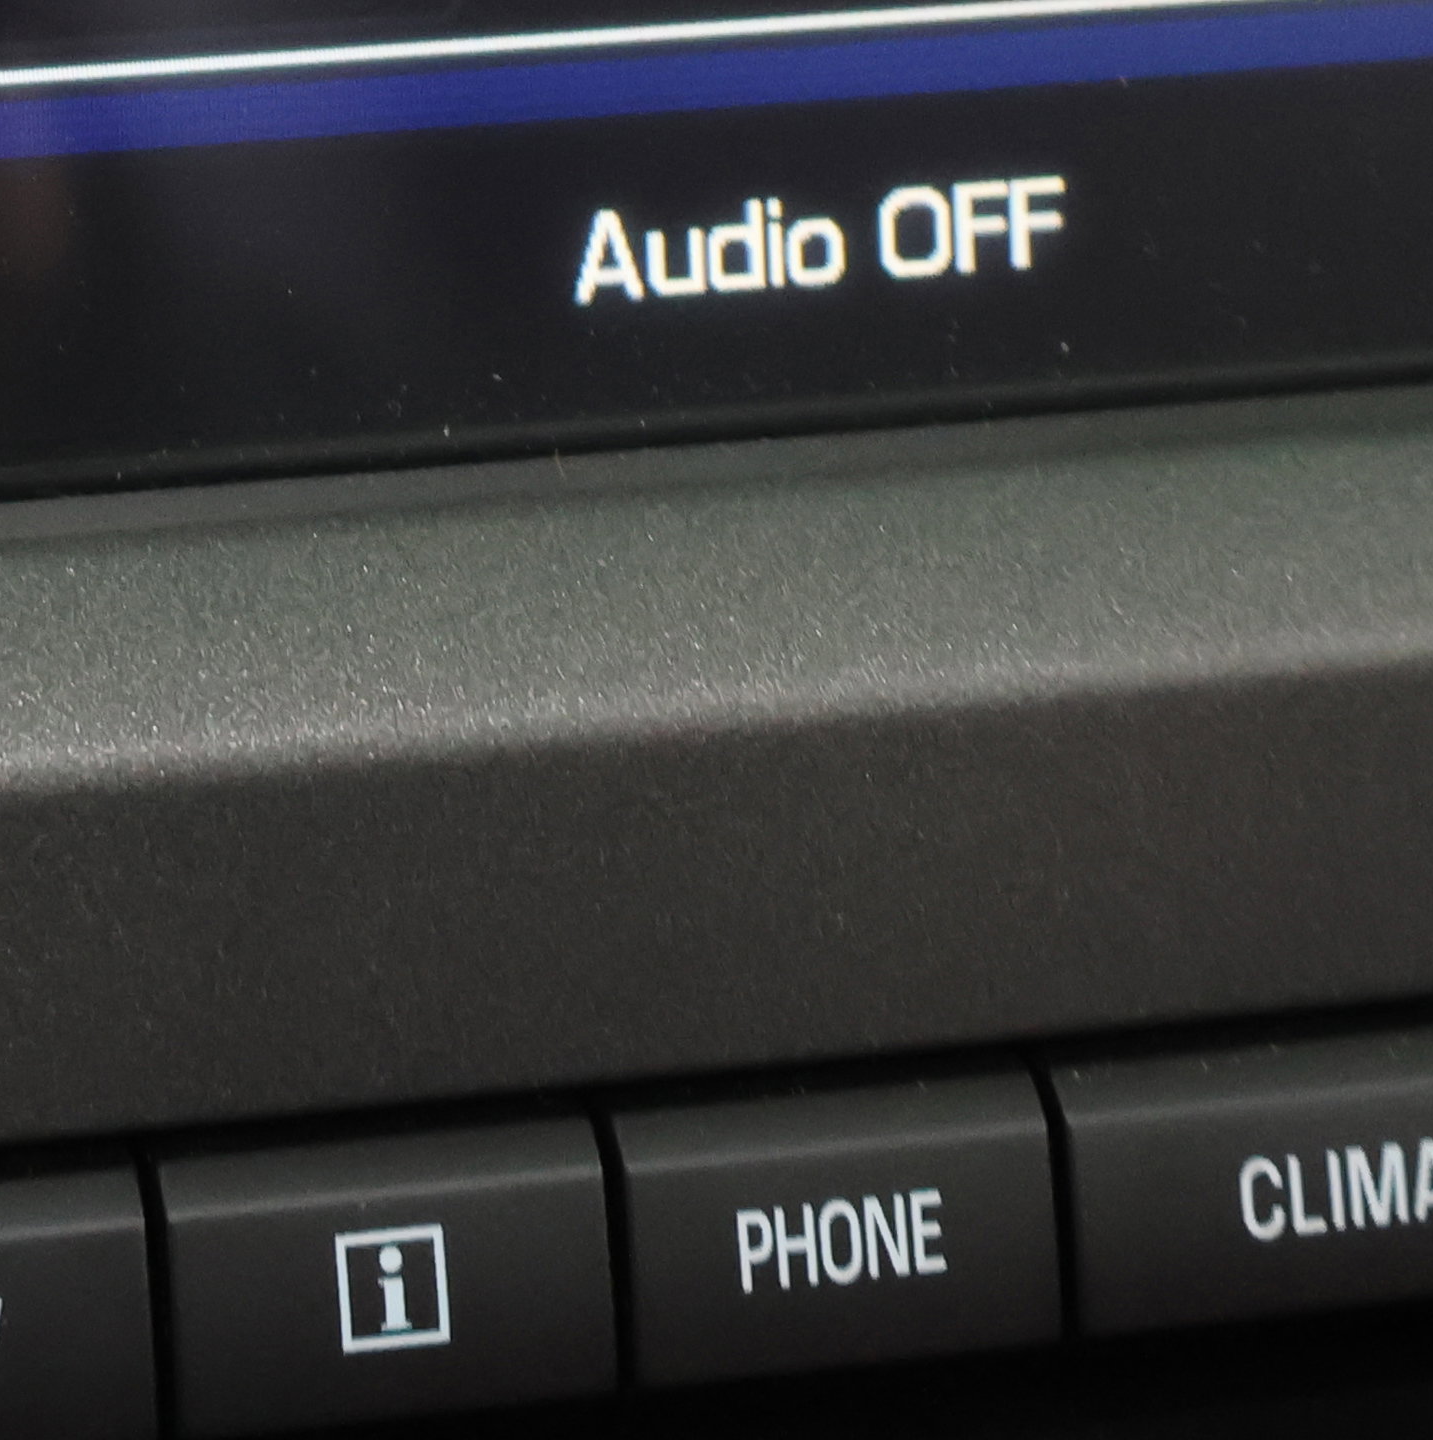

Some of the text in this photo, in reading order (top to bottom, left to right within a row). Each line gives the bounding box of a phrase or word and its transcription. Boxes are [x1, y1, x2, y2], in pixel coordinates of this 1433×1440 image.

[574, 175, 1065, 306] Audio OFF
[737, 1190, 946, 1295] PHONE
